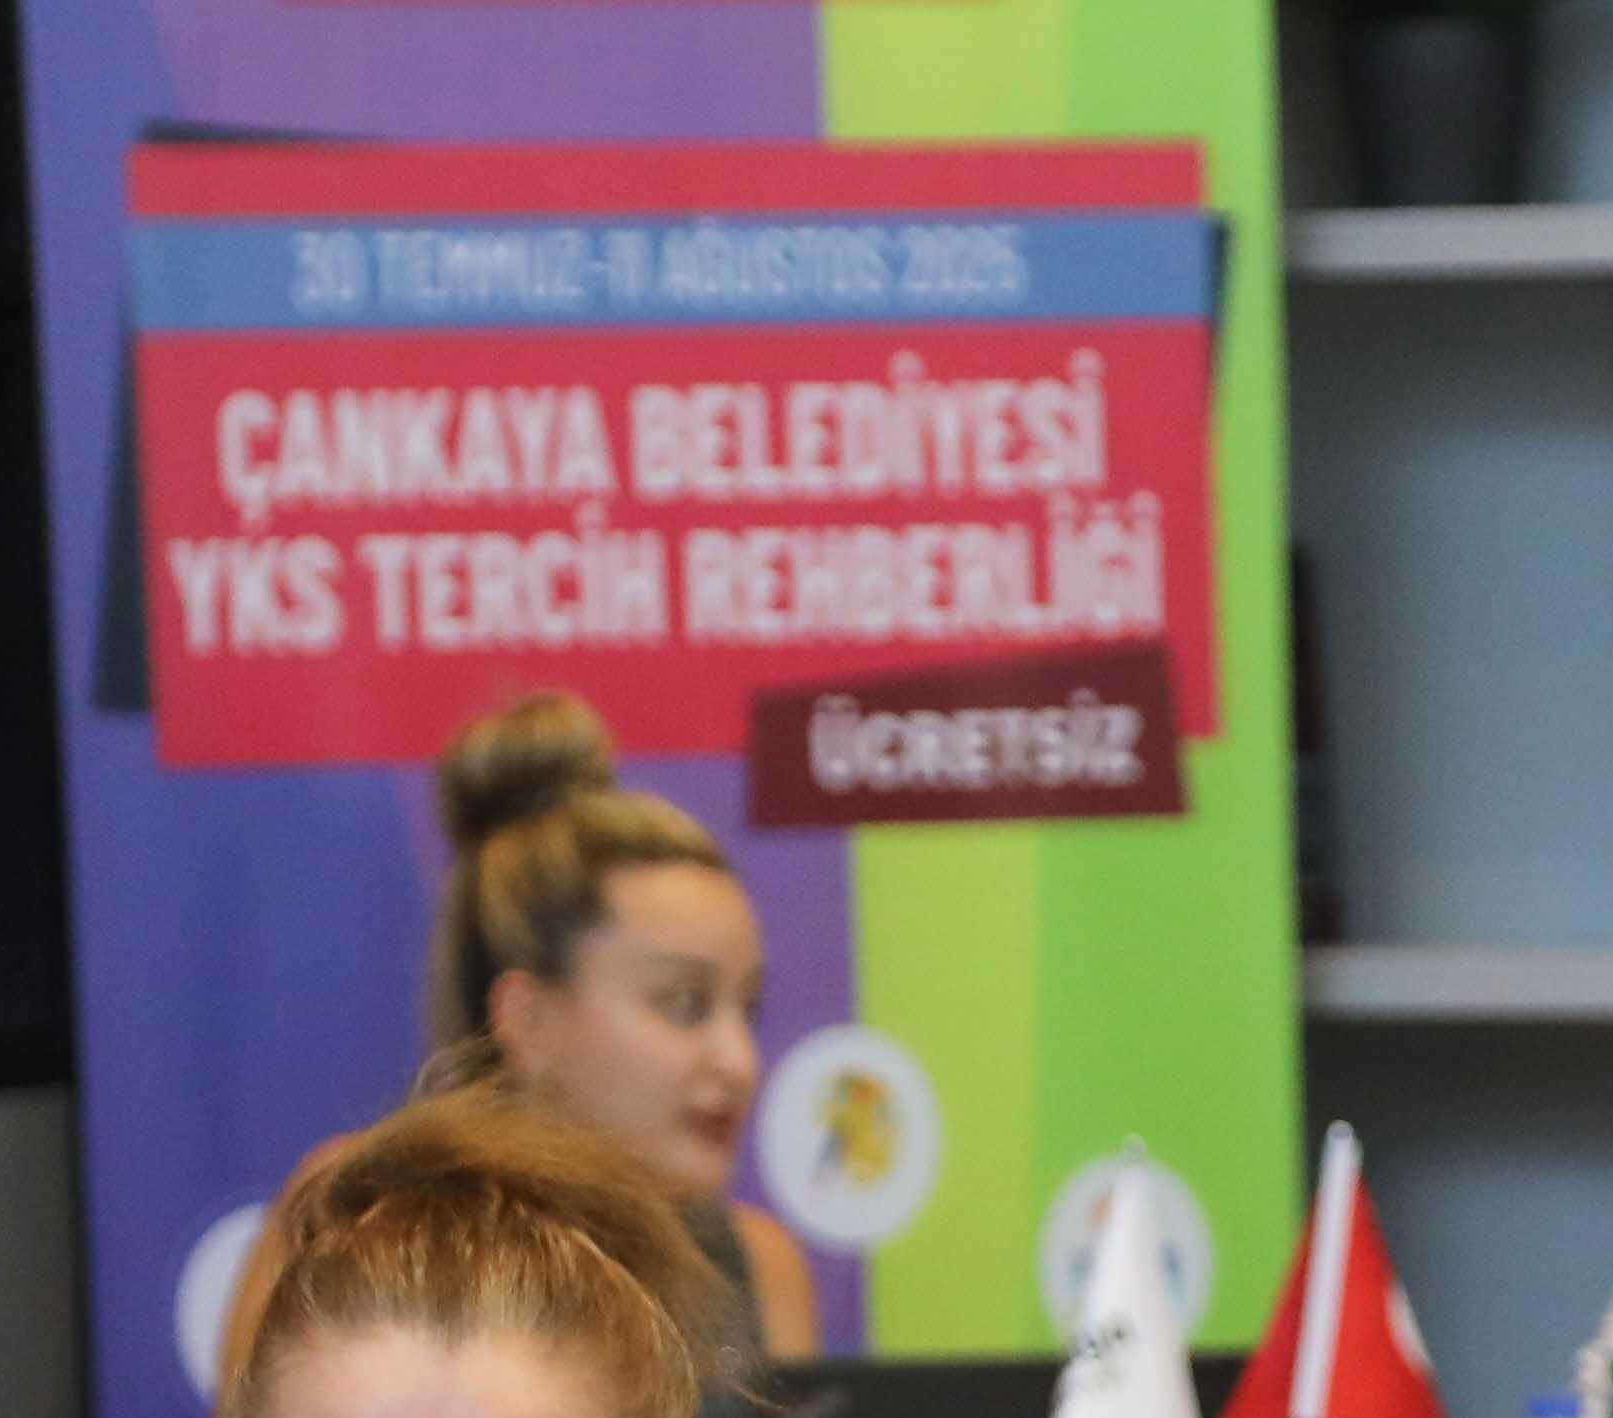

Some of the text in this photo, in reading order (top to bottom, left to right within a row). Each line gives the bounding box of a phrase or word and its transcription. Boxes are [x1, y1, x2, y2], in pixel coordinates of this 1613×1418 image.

[292, 230, 368, 312] 30
[660, 218, 886, 302] AĞUSTOS
[216, 348, 1108, 526] ÇANKAYA BELEDİYESİ
[170, 492, 1166, 656] YKS TERCİH REHBERLİĞİ
[808, 690, 1142, 790] ÜCRETSİZ
